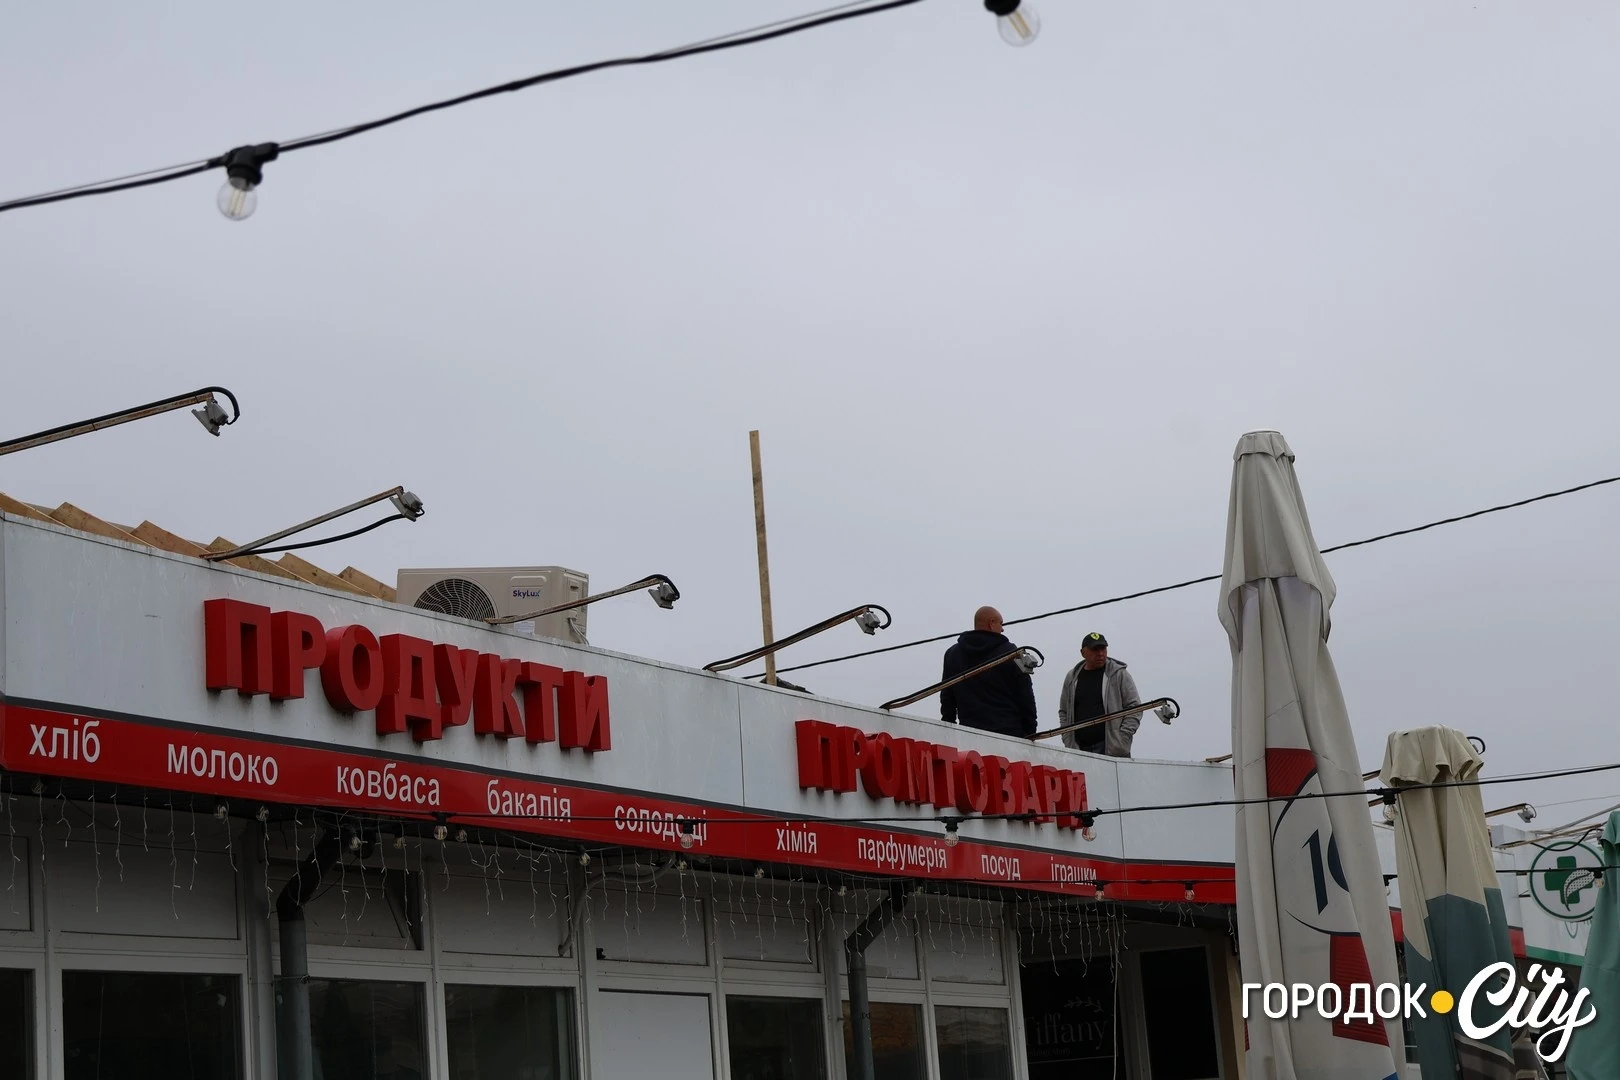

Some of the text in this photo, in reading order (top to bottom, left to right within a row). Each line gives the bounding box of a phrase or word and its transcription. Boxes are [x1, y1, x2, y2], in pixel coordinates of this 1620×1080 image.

[512, 589, 541, 599] SkyLux
[204, 598, 611, 752] ПРОДУКТИ
[29, 718, 100, 763] хліб
[167, 743, 279, 786] молоко
[336, 762, 441, 806] ковбаса
[487, 779, 571, 823] бакалія
[795, 719, 1088, 830] ПРОМТОВАРИ
[776, 822, 1097, 889] хімія парфумерія посуд іграшки
